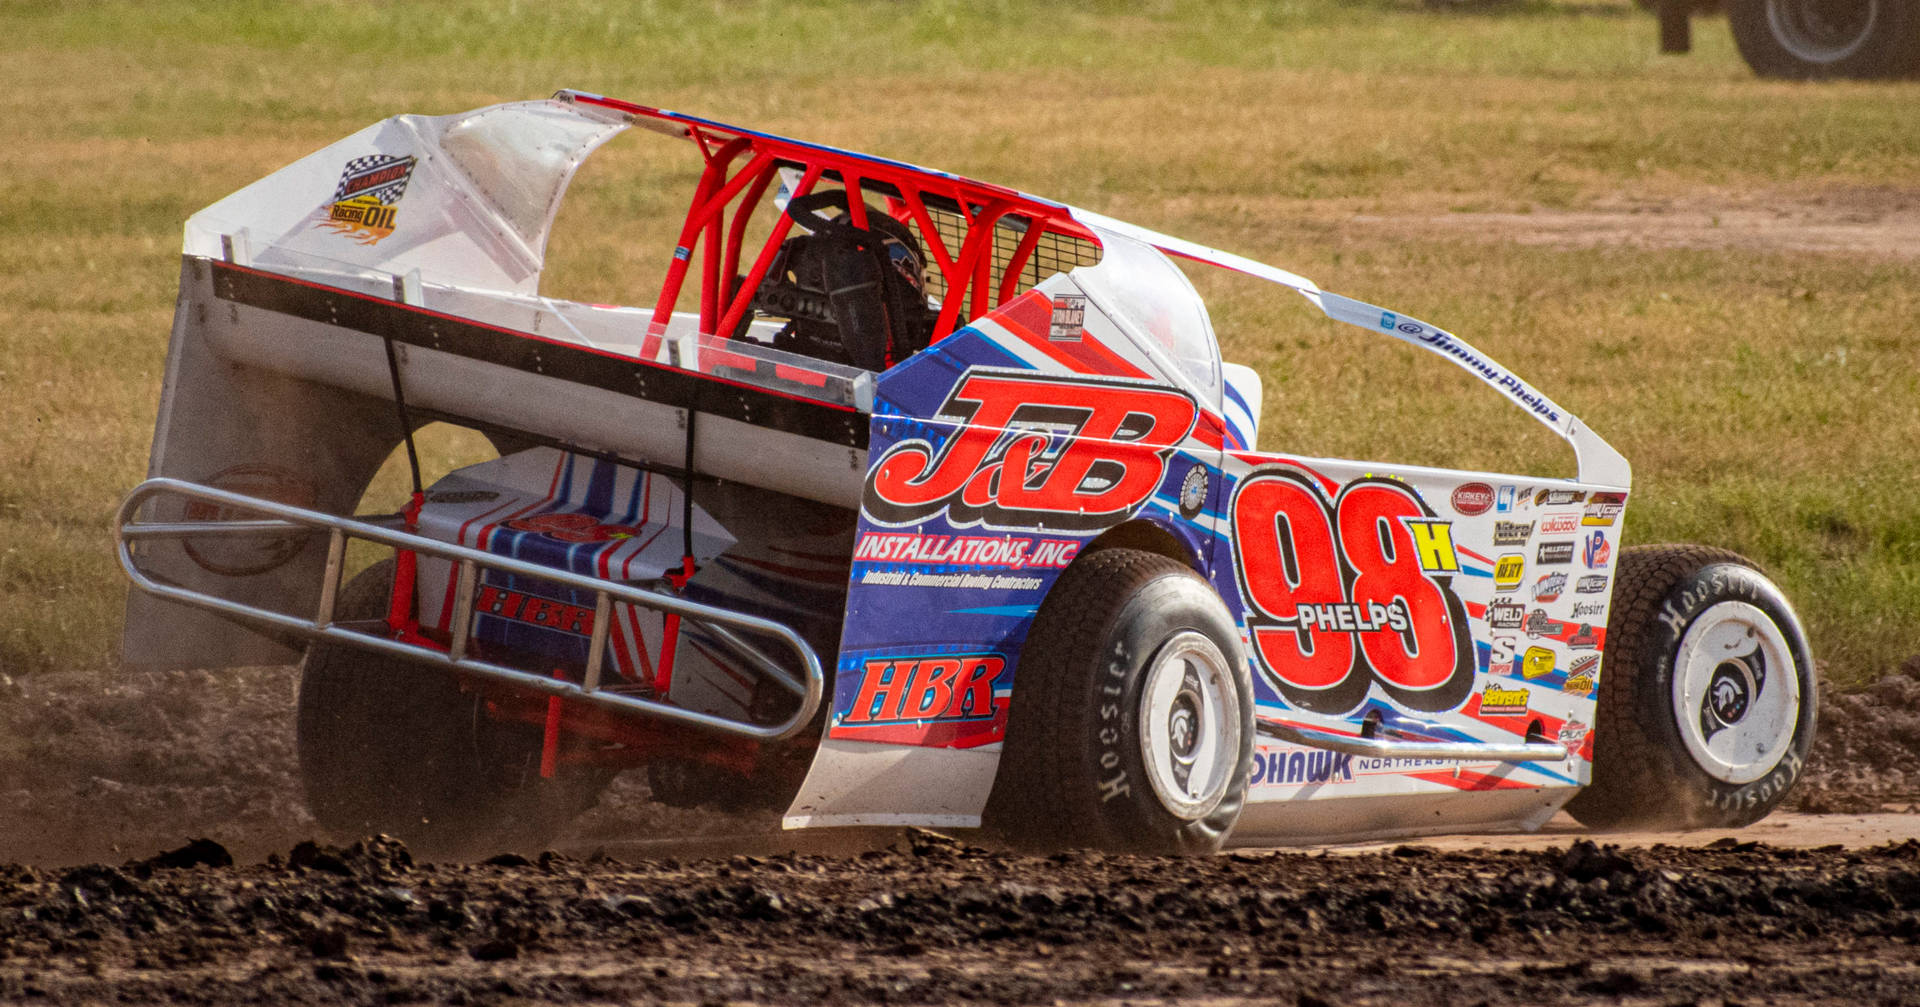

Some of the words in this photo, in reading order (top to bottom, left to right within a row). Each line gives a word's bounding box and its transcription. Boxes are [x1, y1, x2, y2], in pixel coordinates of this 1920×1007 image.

[363, 206, 395, 230] OIL
[866, 370, 1198, 522] J&B
[855, 535, 1029, 567] INSTALLATIONS,
[862, 570, 904, 586] Industrial
[909, 572, 961, 588] Commercial
[960, 573, 993, 590] Roofing
[991, 575, 1043, 590] Contractors
[1231, 472, 1467, 705] 98
[1409, 520, 1461, 572] H
[1297, 603, 1409, 631] PHELPS
[1493, 607, 1523, 622] WELD
[843, 655, 1007, 725] HBR
[1250, 751, 1353, 784] OHAWK
